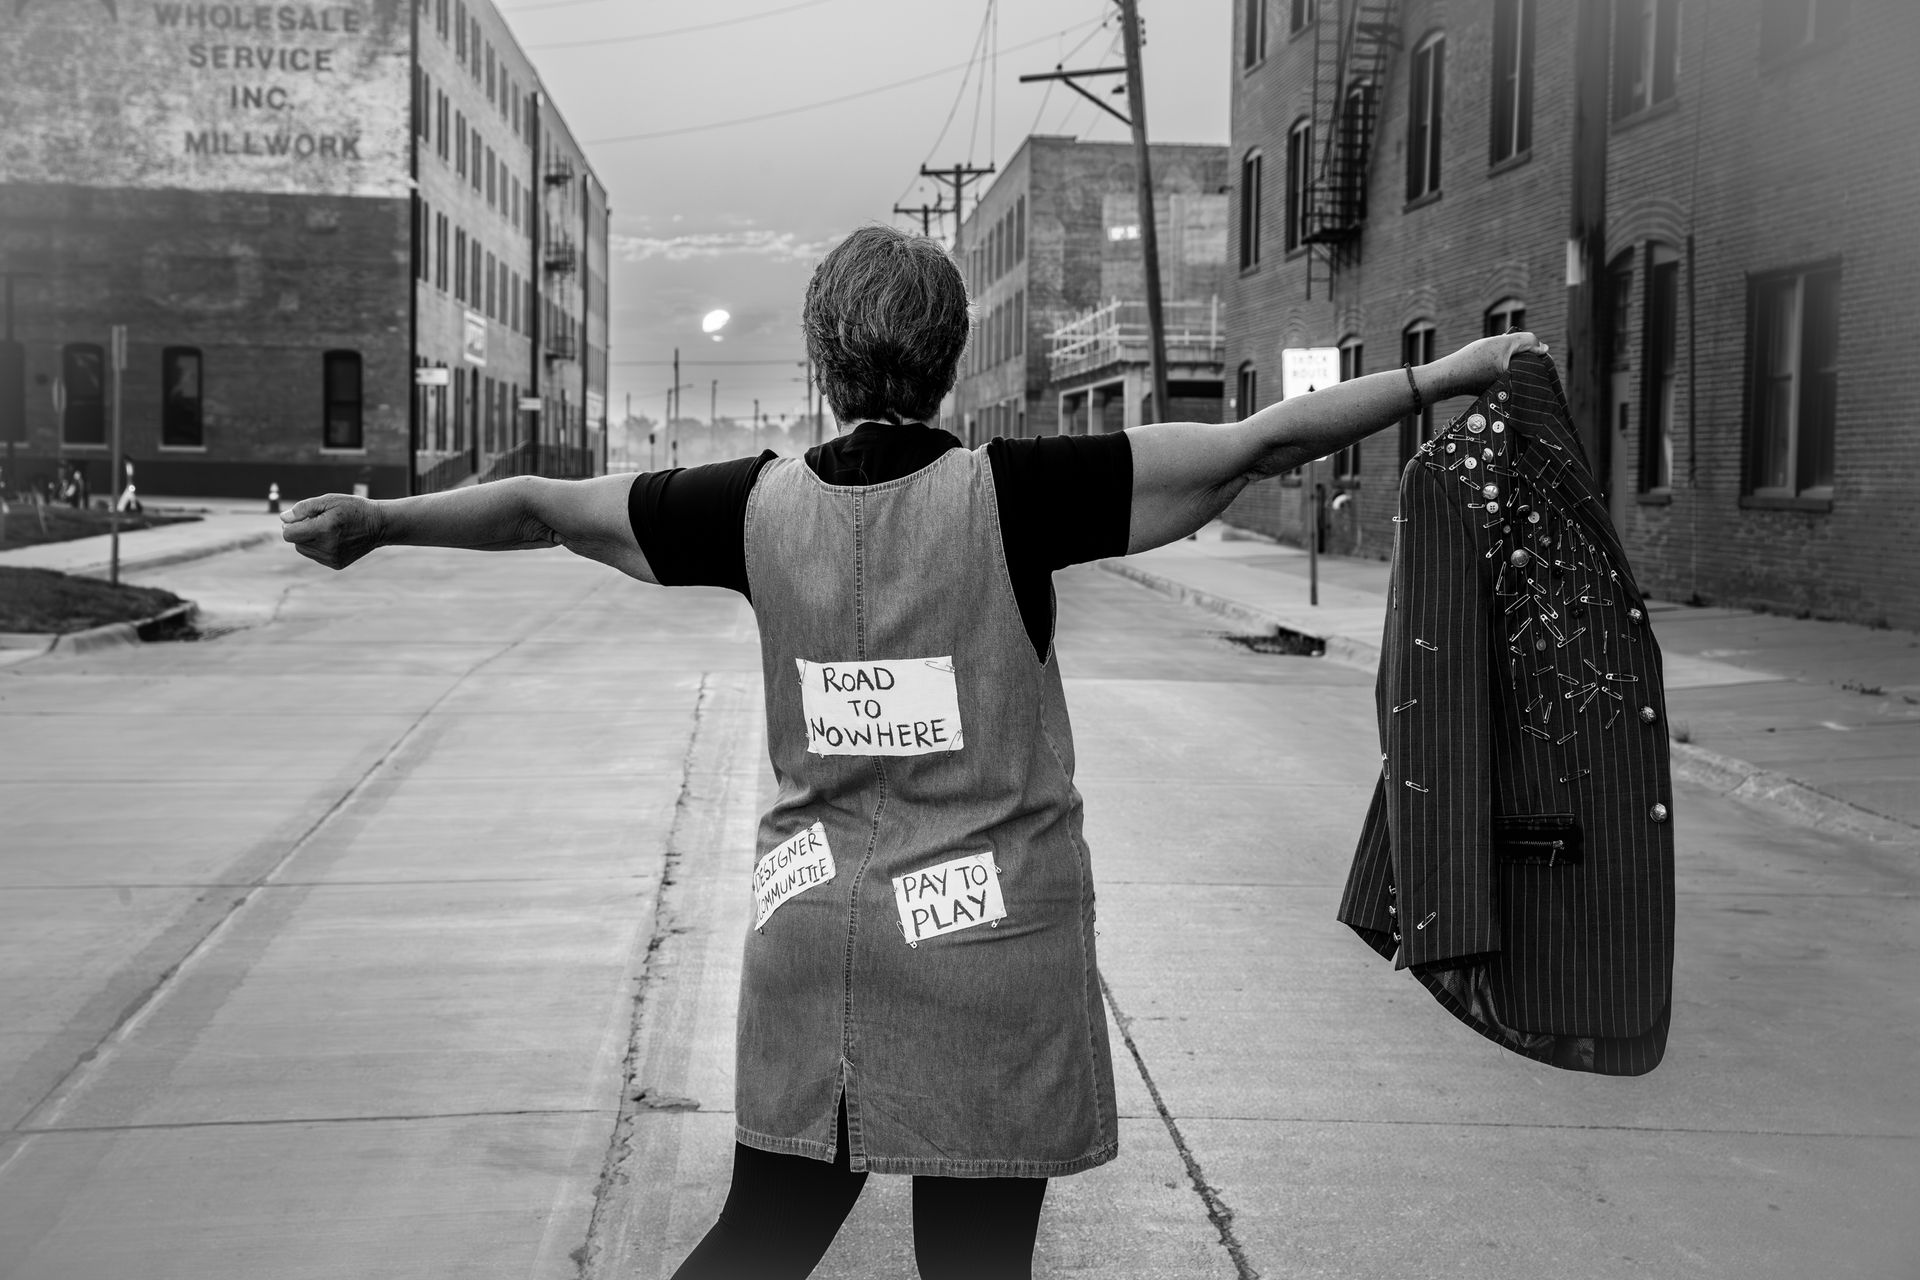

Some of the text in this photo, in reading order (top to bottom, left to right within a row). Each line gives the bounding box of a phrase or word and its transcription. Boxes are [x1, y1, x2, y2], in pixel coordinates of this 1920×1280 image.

[154, 3, 360, 33] WHOLESALE
[188, 44, 333, 72] SERVICE
[230, 85, 295, 110] INC.
[185, 130, 361, 160] MILLWORK
[822, 667, 895, 693] ROAD
[847, 699, 881, 719] TO
[810, 717, 949, 748] NOWHERE
[754, 832, 823, 893] DESIGNER
[902, 864, 988, 903] PAY TO
[911, 889, 987, 938] PLAY
